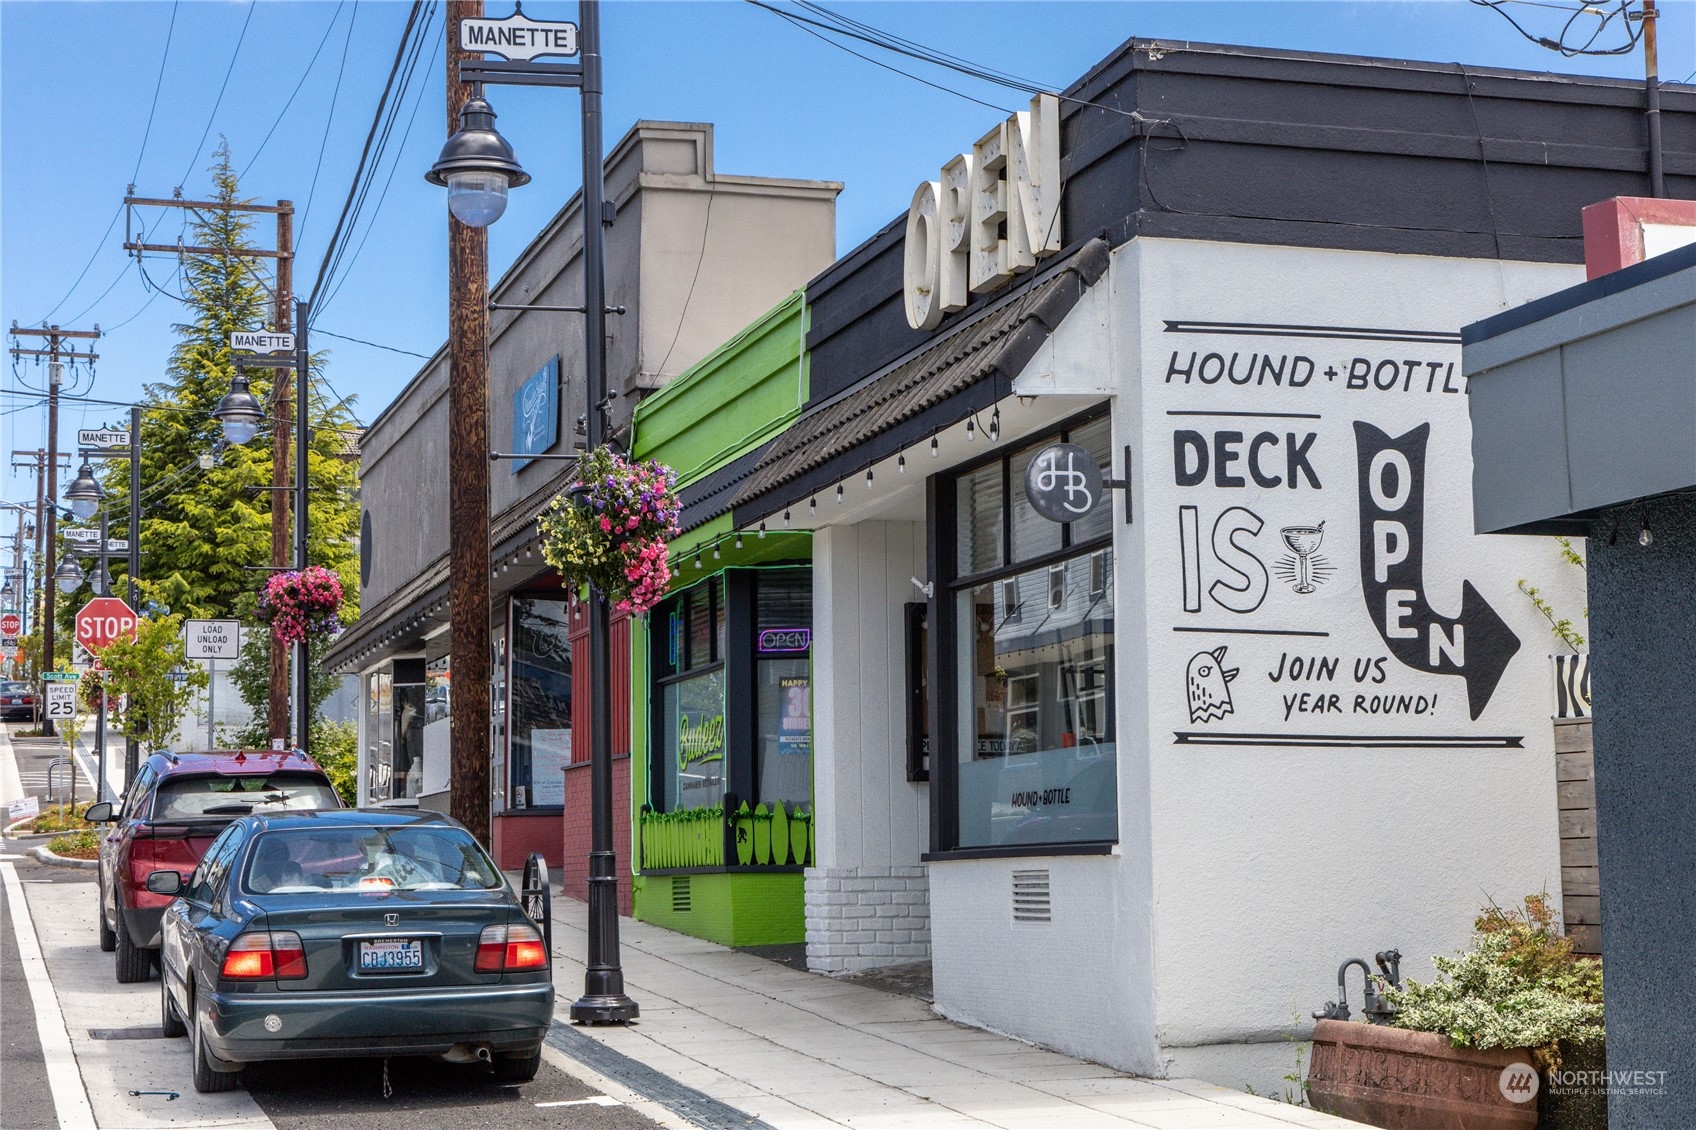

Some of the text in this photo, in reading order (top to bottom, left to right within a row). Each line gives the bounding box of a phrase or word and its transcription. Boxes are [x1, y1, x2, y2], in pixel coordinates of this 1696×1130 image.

[469, 25, 568, 48] MANETTE
[903, 92, 1062, 330] OPEN
[234, 334, 290, 348] MANETTE
[1165, 351, 1315, 387] HOUND
[1346, 357, 1471, 394] BOTTL
[82, 433, 126, 443] MANETTE
[1173, 429, 1323, 489] DECK
[66, 530, 98, 538] MANETTE
[1178, 505, 1269, 614] IS
[1369, 448, 1465, 668] OPEN
[1, 620, 20, 629] STOP
[80, 617, 133, 638] STOP
[203, 625, 223, 634] LOAD
[197, 635, 228, 643] UNLOAD
[762, 632, 807, 647] OPEN
[202, 645, 222, 653] ONLY
[1268, 652, 1388, 683] JOIN US
[46, 672, 62, 680] Scott
[781, 679, 808, 687] HAPPY
[50, 686, 75, 694] SPEED
[50, 701, 73, 715] 25
[1283, 693, 1438, 722] YEAR ROUND!
[683, 780, 701, 790] CANNABIS
